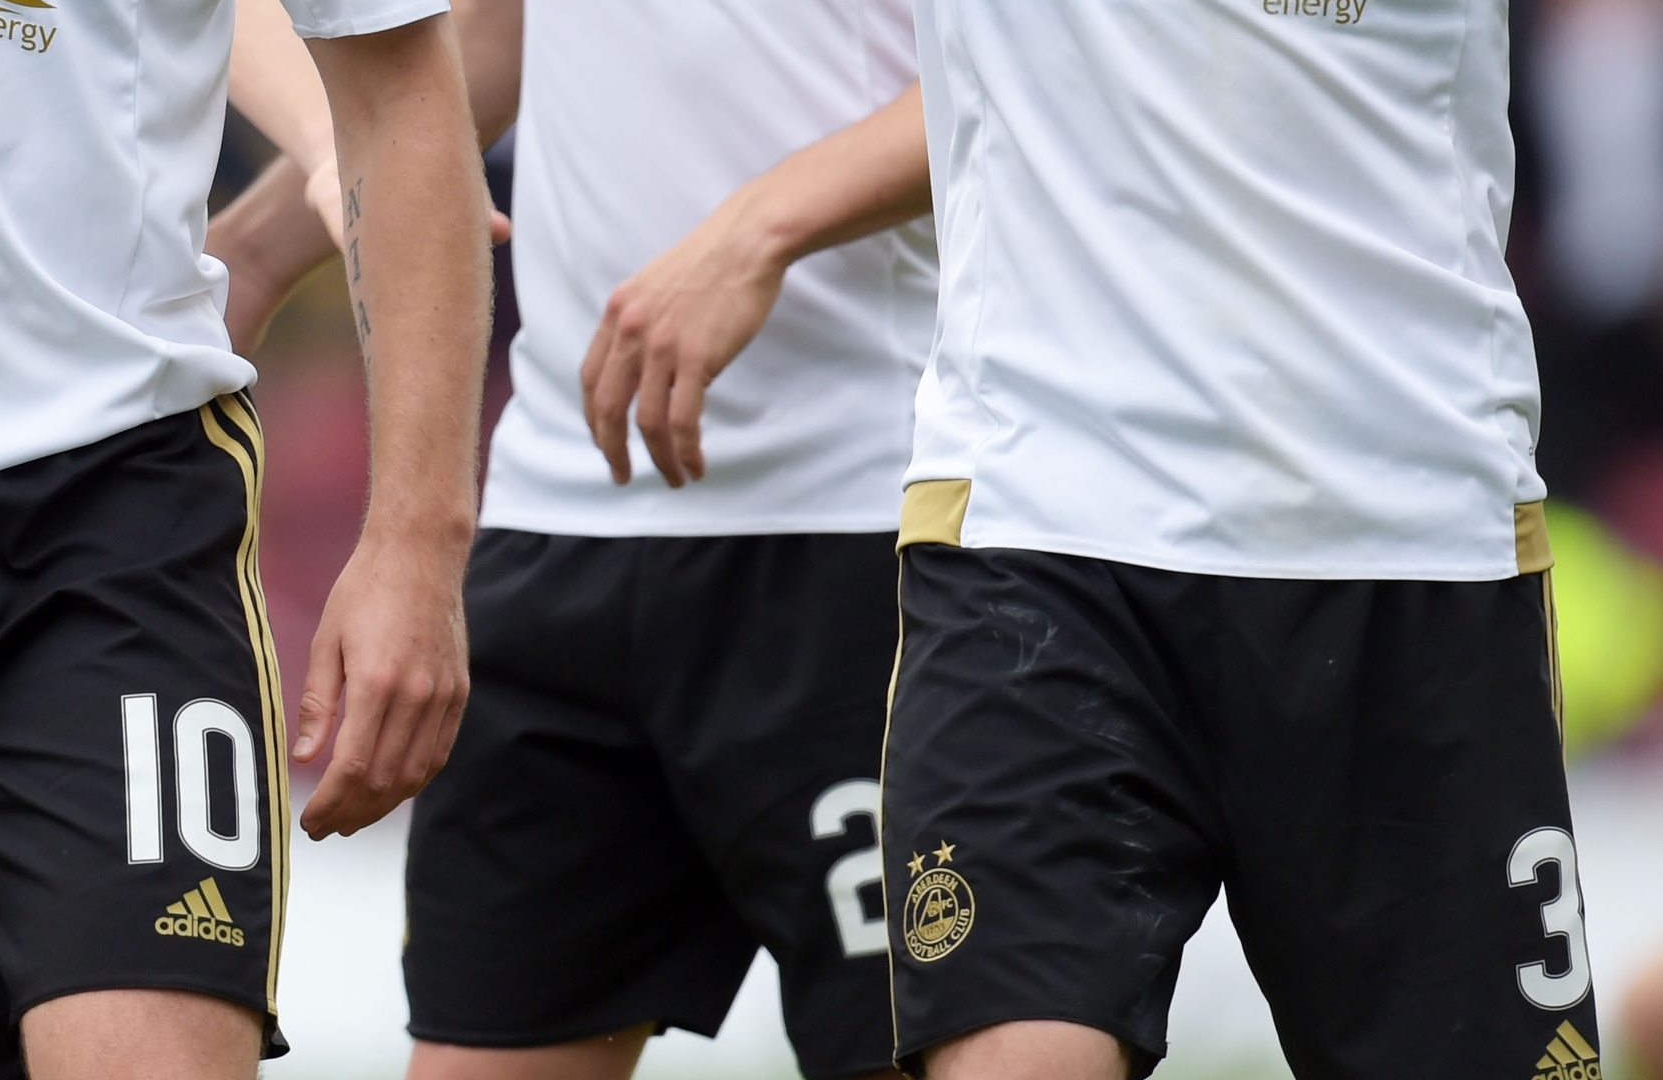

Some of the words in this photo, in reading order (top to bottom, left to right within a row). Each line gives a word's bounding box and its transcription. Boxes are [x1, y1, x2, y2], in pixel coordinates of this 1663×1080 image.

[121, 692, 261, 872] 10
[809, 777, 890, 959] 2
[155, 914, 245, 947] adidas
[907, 929, 951, 957] FOOTBALL
[950, 908, 970, 940] CLUB
[1506, 826, 1592, 1011] 3
